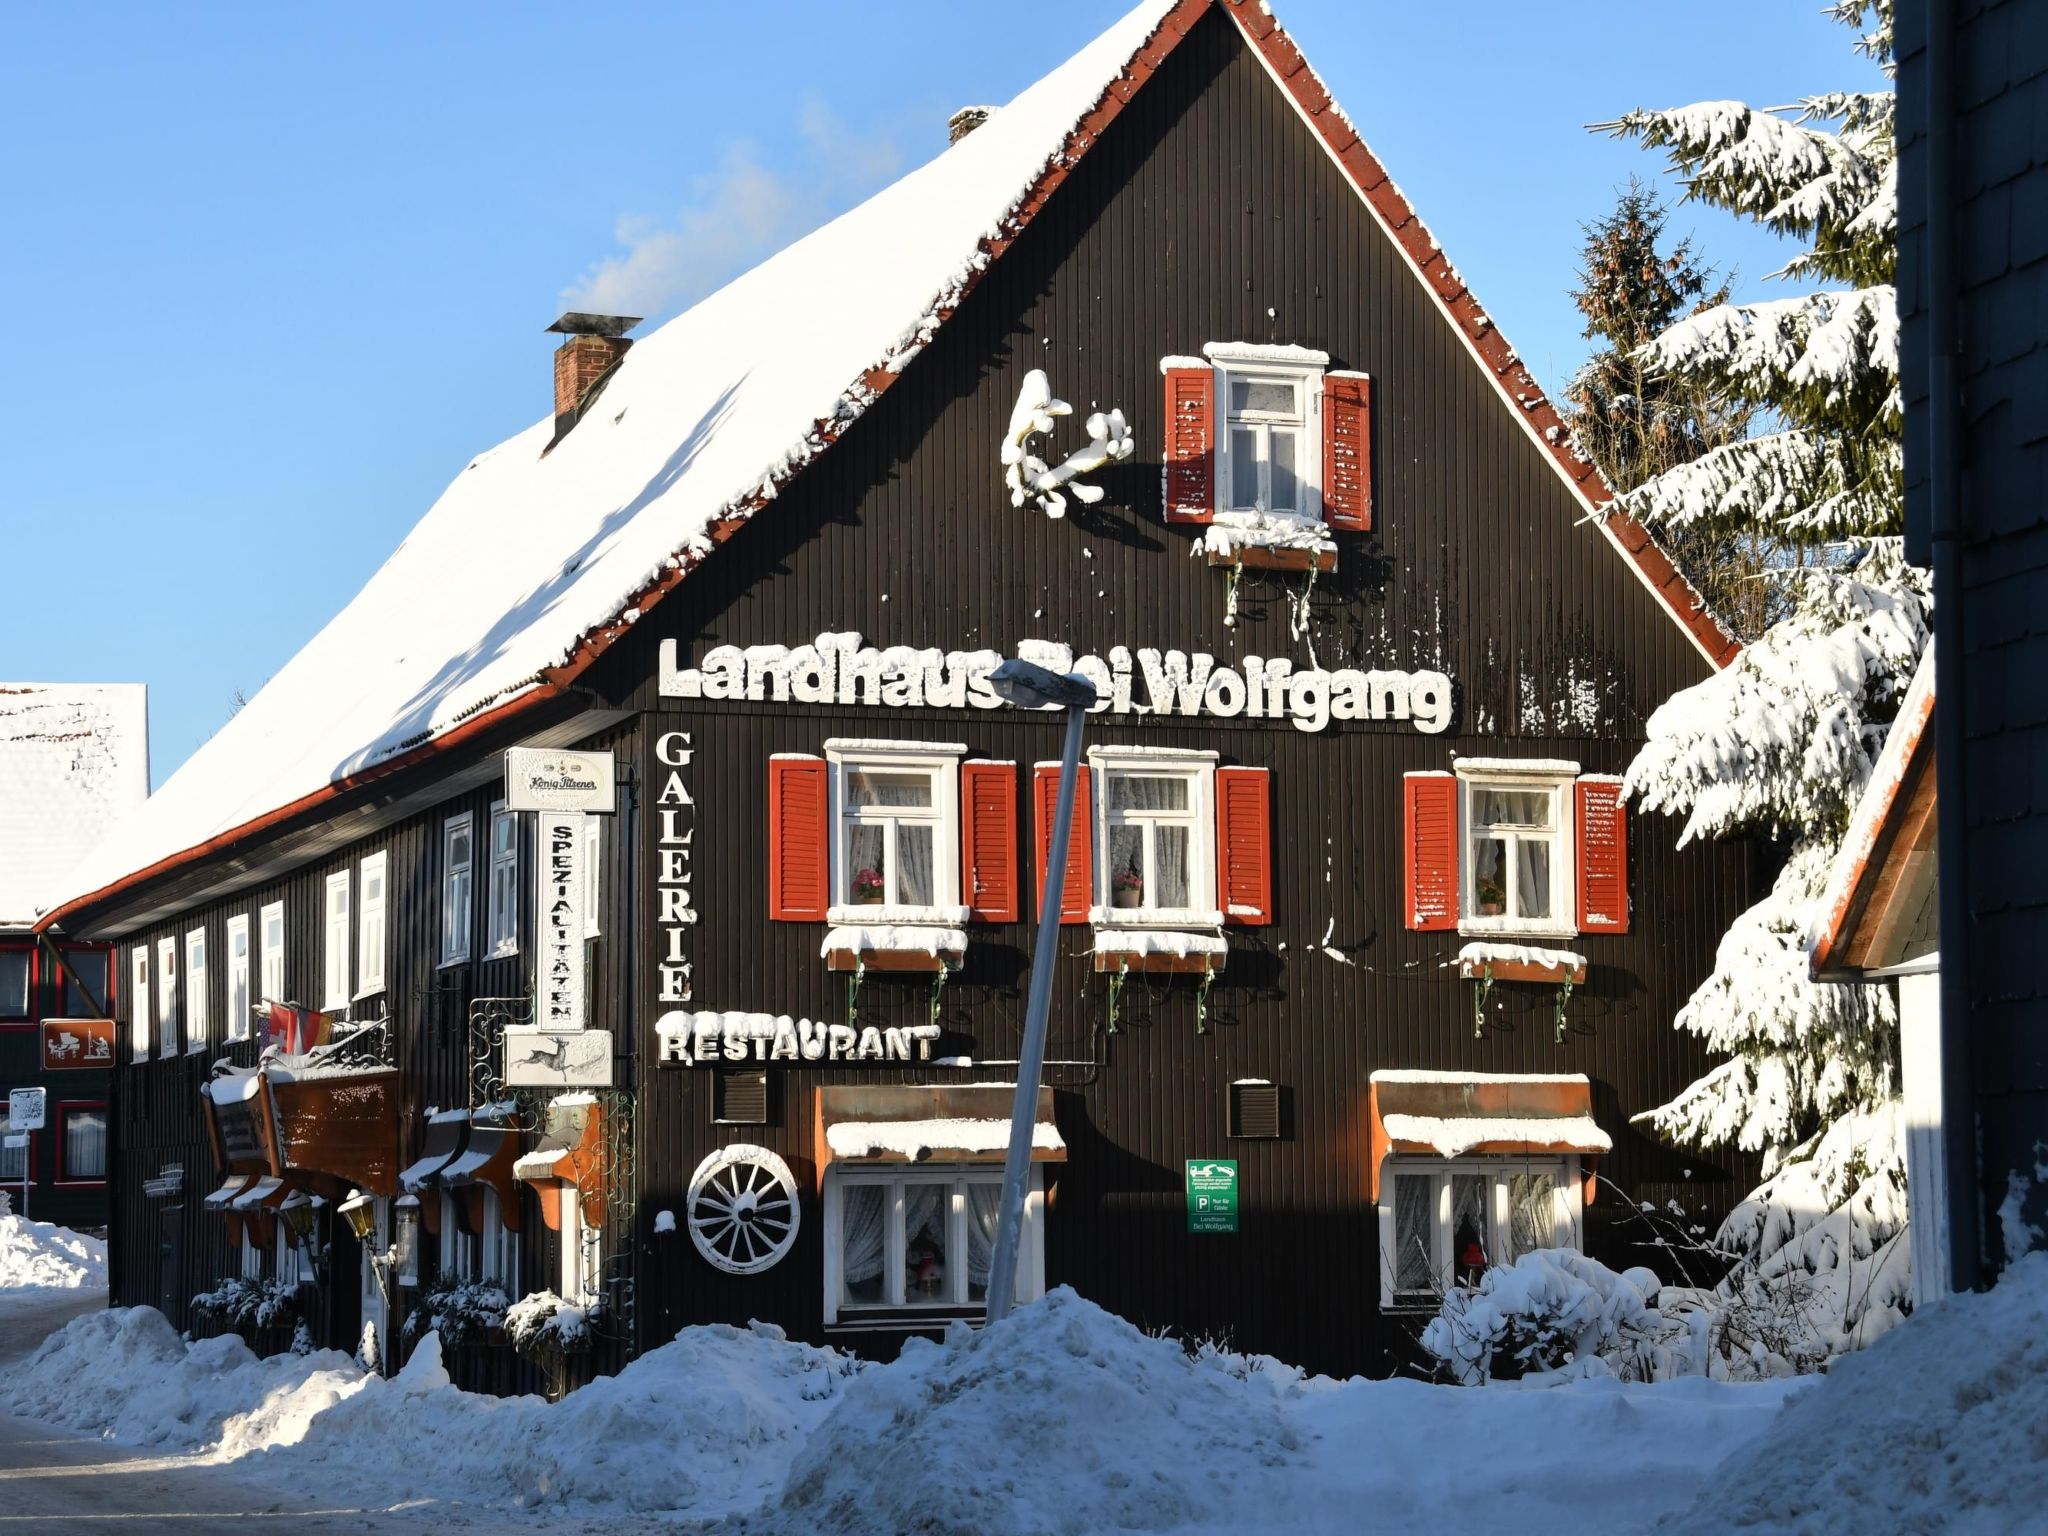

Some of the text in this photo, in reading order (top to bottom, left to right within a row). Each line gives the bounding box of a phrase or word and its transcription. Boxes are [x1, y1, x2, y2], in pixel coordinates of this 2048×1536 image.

[659, 634, 1006, 709] Landhaus
[1138, 647, 1452, 734] Wolfgang
[530, 776, 597, 790] König Pilsener
[656, 732, 696, 1002] GALERIE
[657, 1014, 940, 1061] RESTAURANT
[1199, 1198, 1208, 1210] P
